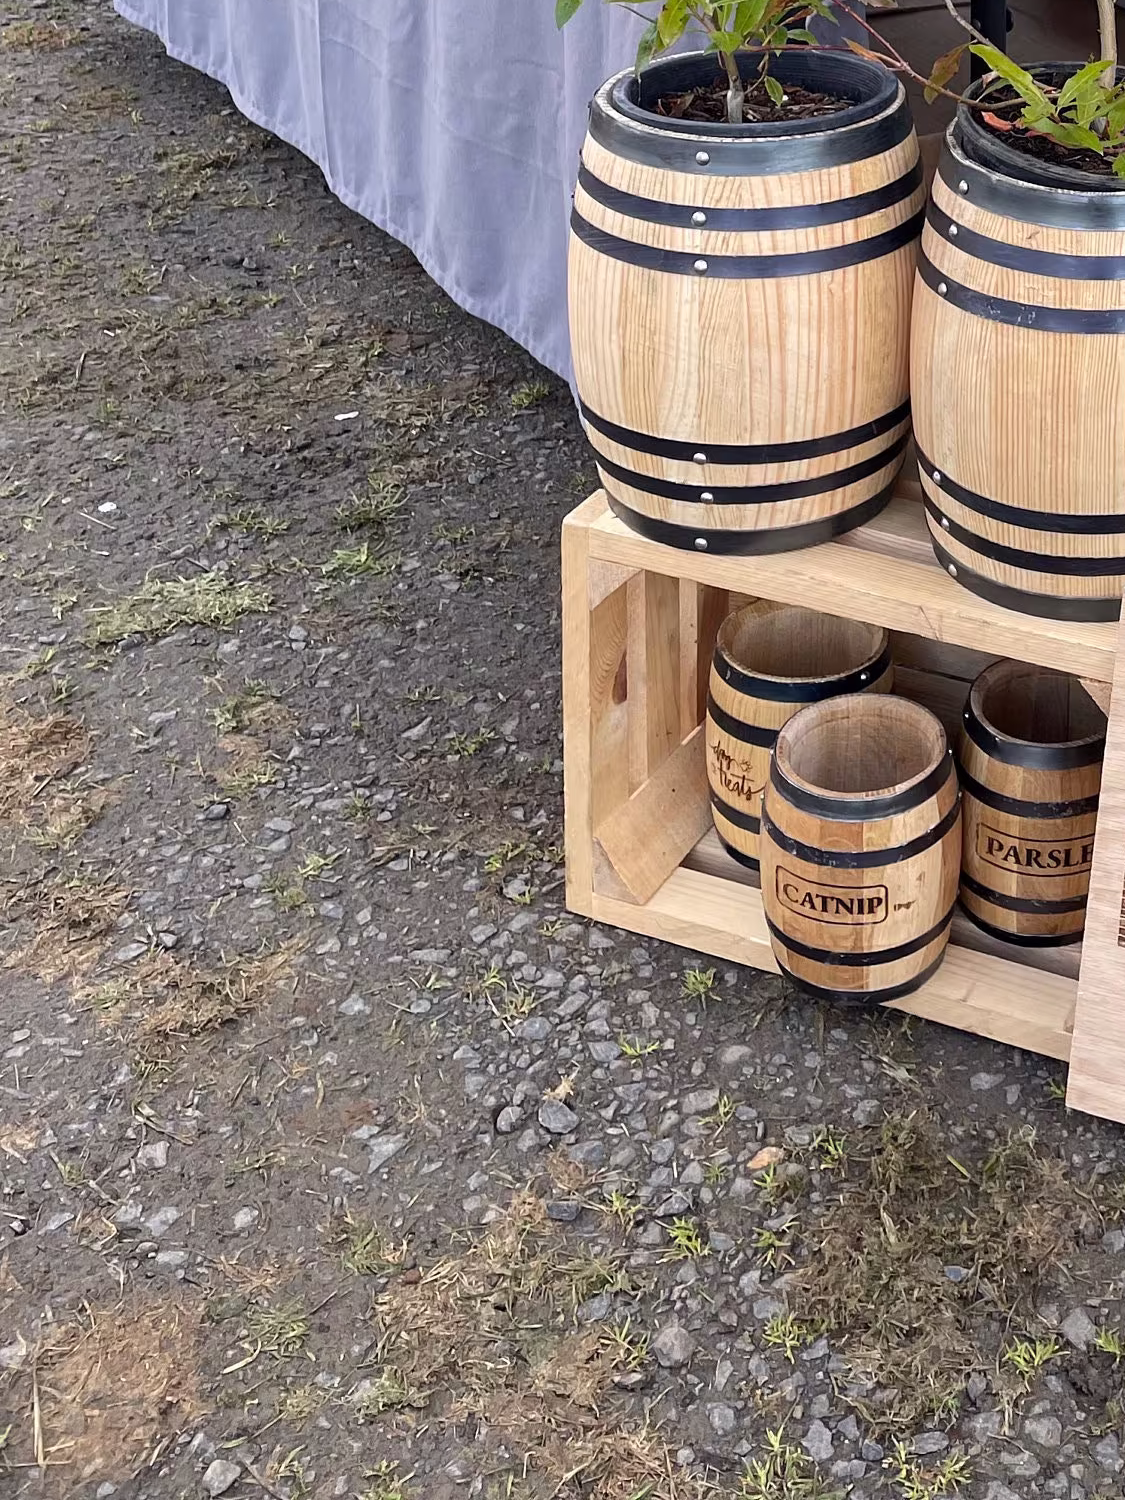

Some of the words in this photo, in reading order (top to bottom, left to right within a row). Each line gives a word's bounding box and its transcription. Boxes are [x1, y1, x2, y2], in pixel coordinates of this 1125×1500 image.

[709, 740, 740, 771] dog
[717, 760, 768, 801] treats
[985, 836, 1094, 869] PARSLE
[782, 883, 883, 916] CATNIP
